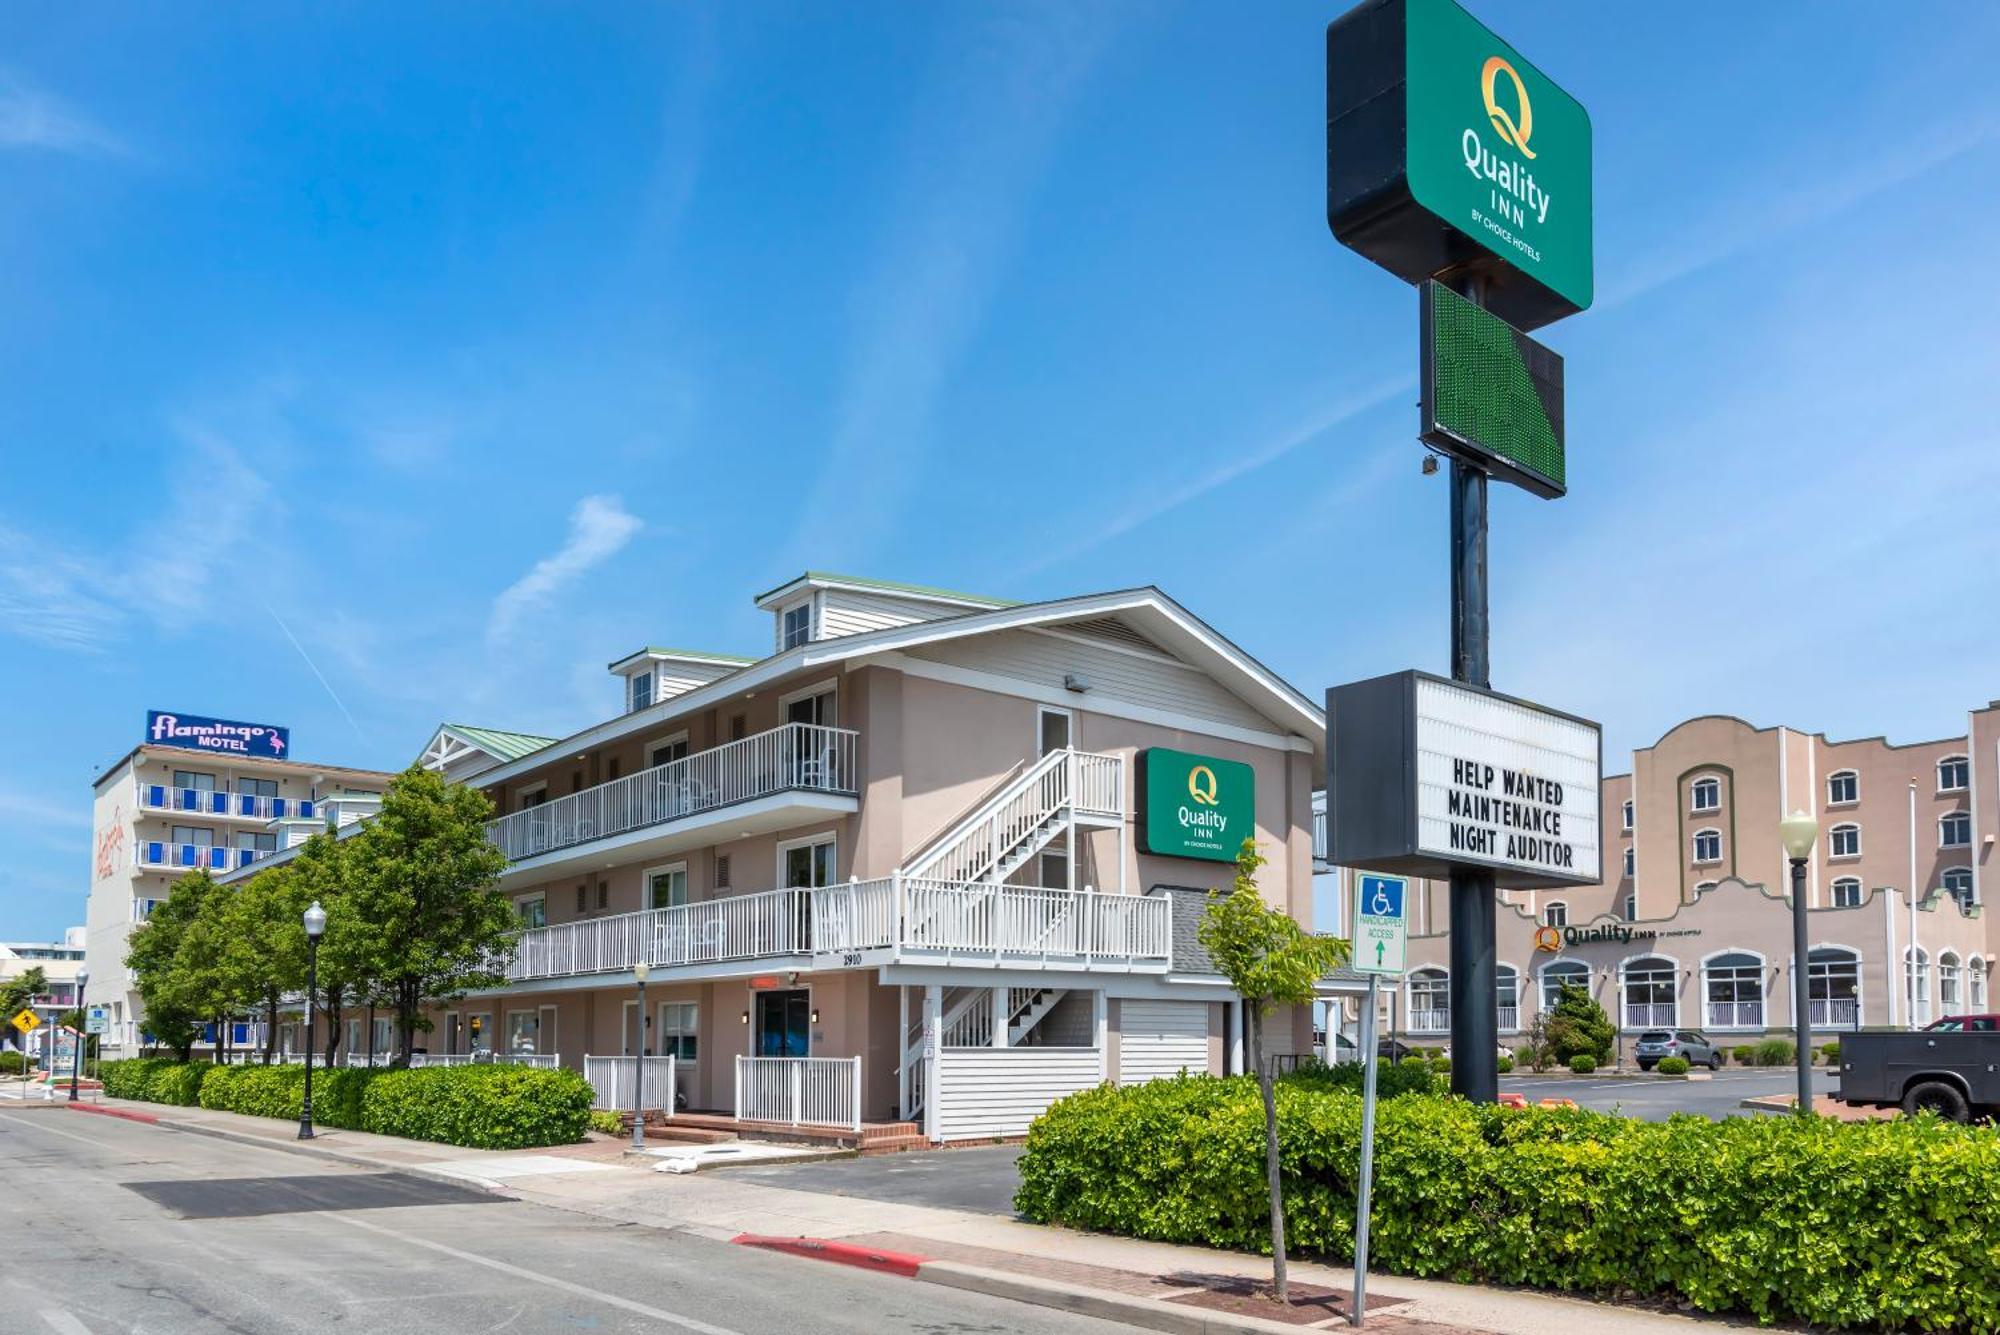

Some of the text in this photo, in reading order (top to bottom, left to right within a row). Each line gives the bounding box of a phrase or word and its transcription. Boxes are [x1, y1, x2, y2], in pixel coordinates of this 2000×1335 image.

[1462, 128, 1550, 224] Quality
[1491, 189, 1524, 230] INN
[1471, 208, 1541, 262] BY CHOICE HOTELS
[151, 714, 265, 740] flamingo
[198, 736, 248, 751] MOTEL
[1454, 758, 1563, 806] HELP WANTED
[1178, 806, 1227, 832] Quality
[1449, 789, 1561, 836] MAINTENANCE
[1194, 827, 1213, 839] INN
[1450, 823, 1572, 867] NIGHT AUDITOR
[1368, 928, 1394, 939] ACCESS
[1563, 924, 1634, 947] Quality
[1634, 930, 1657, 939] INN
